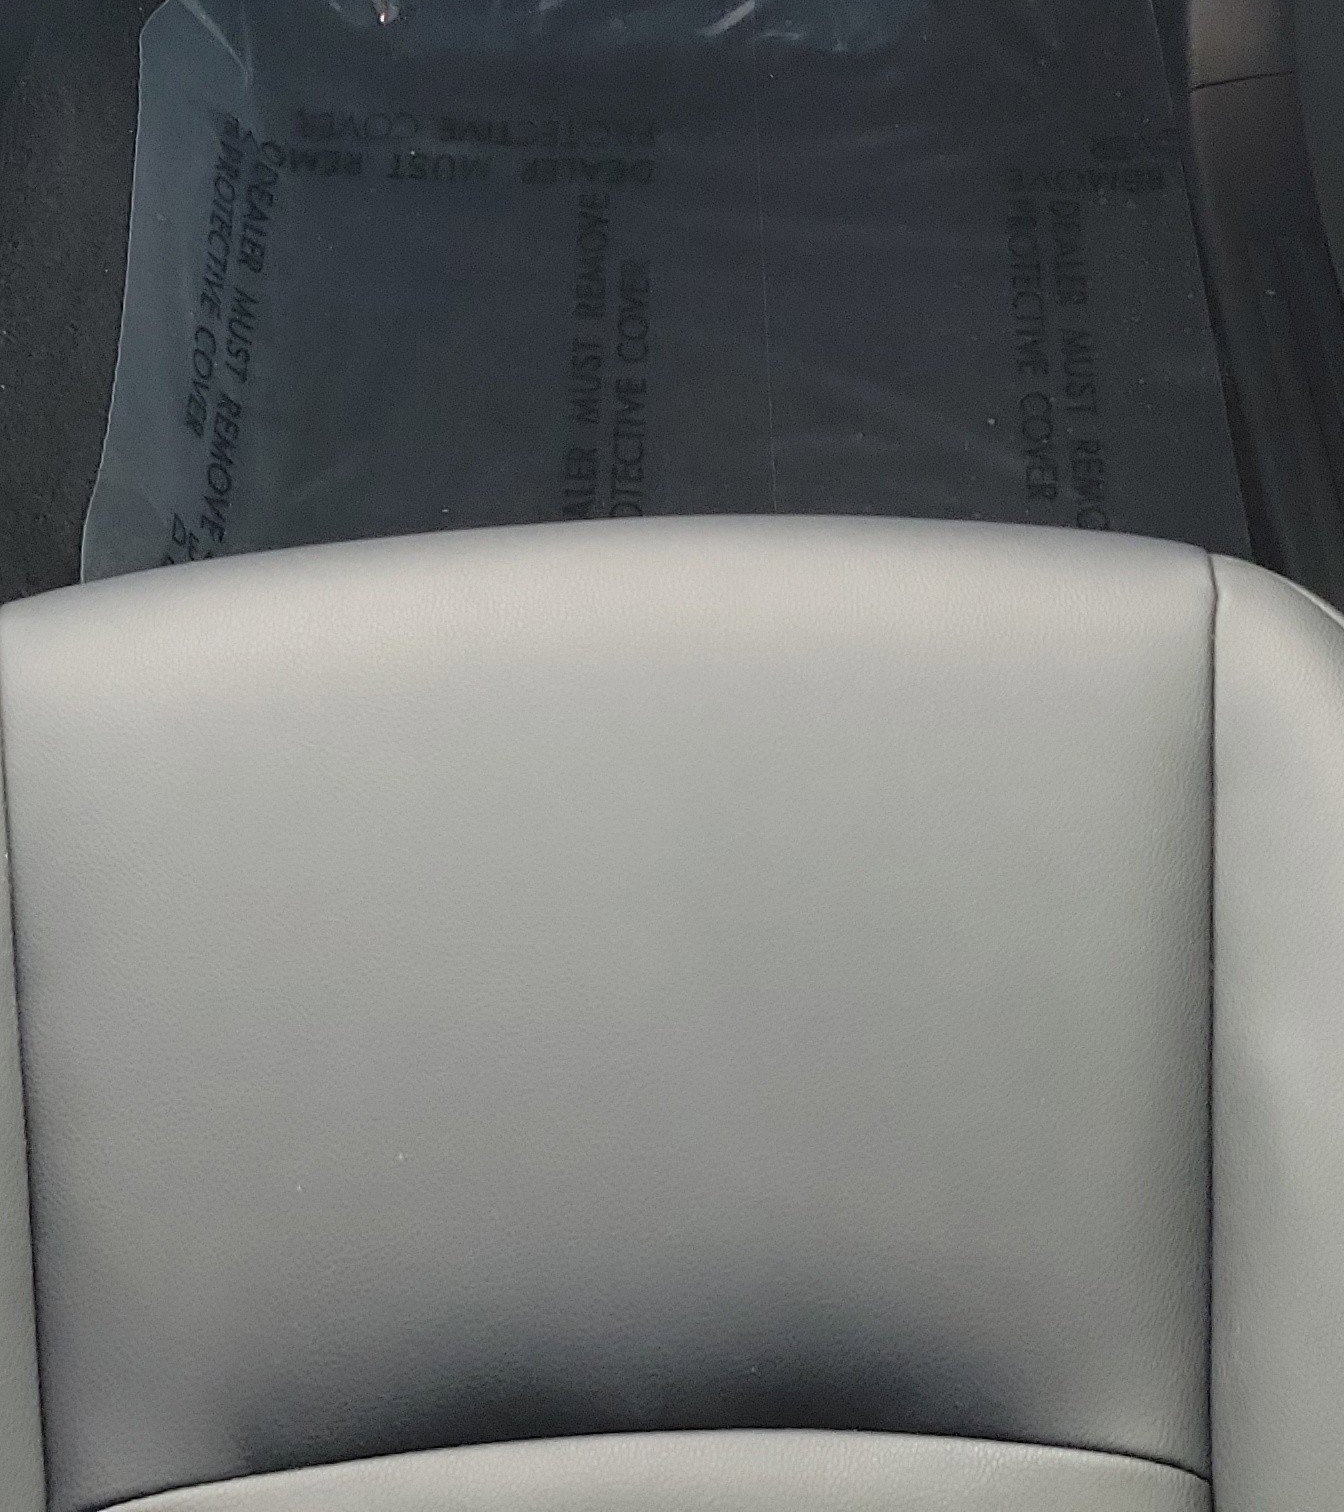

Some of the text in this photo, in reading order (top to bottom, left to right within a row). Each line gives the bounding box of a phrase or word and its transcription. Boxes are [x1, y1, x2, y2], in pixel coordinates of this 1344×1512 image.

[199, 141, 242, 320] PROTECTIVE
[239, 162, 279, 274] DEALER
[571, 192, 610, 319] REMOVE
[224, 286, 260, 383] MUST
[615, 258, 650, 363] COVER
[185, 325, 218, 438] COVER
[569, 337, 603, 425] MUST
[1058, 327, 1100, 418] MUST
[199, 392, 242, 543] REMOVE
[1018, 391, 1061, 505] COVER
